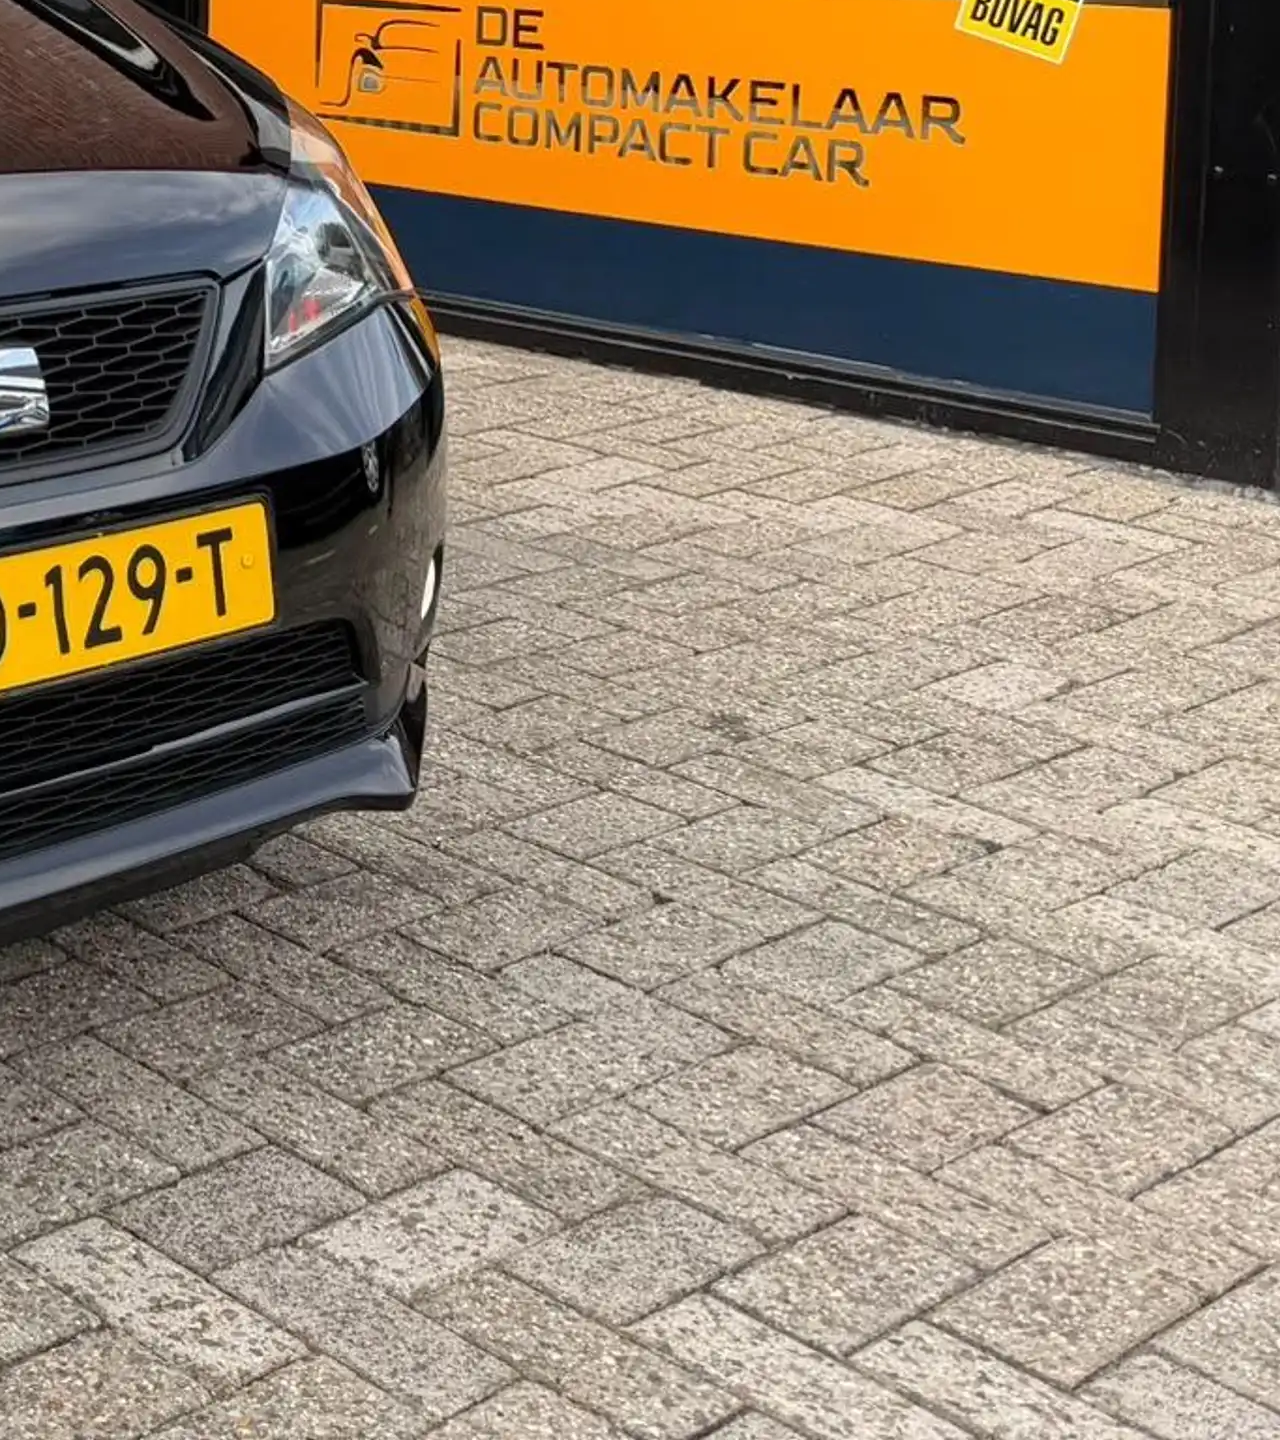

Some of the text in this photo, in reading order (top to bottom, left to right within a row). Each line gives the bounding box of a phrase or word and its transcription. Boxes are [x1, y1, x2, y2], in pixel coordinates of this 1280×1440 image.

[475, 6, 545, 51] DE
[473, 55, 967, 146] AUTOMAKELAAR
[472, 101, 870, 188] COMPACT CAR
